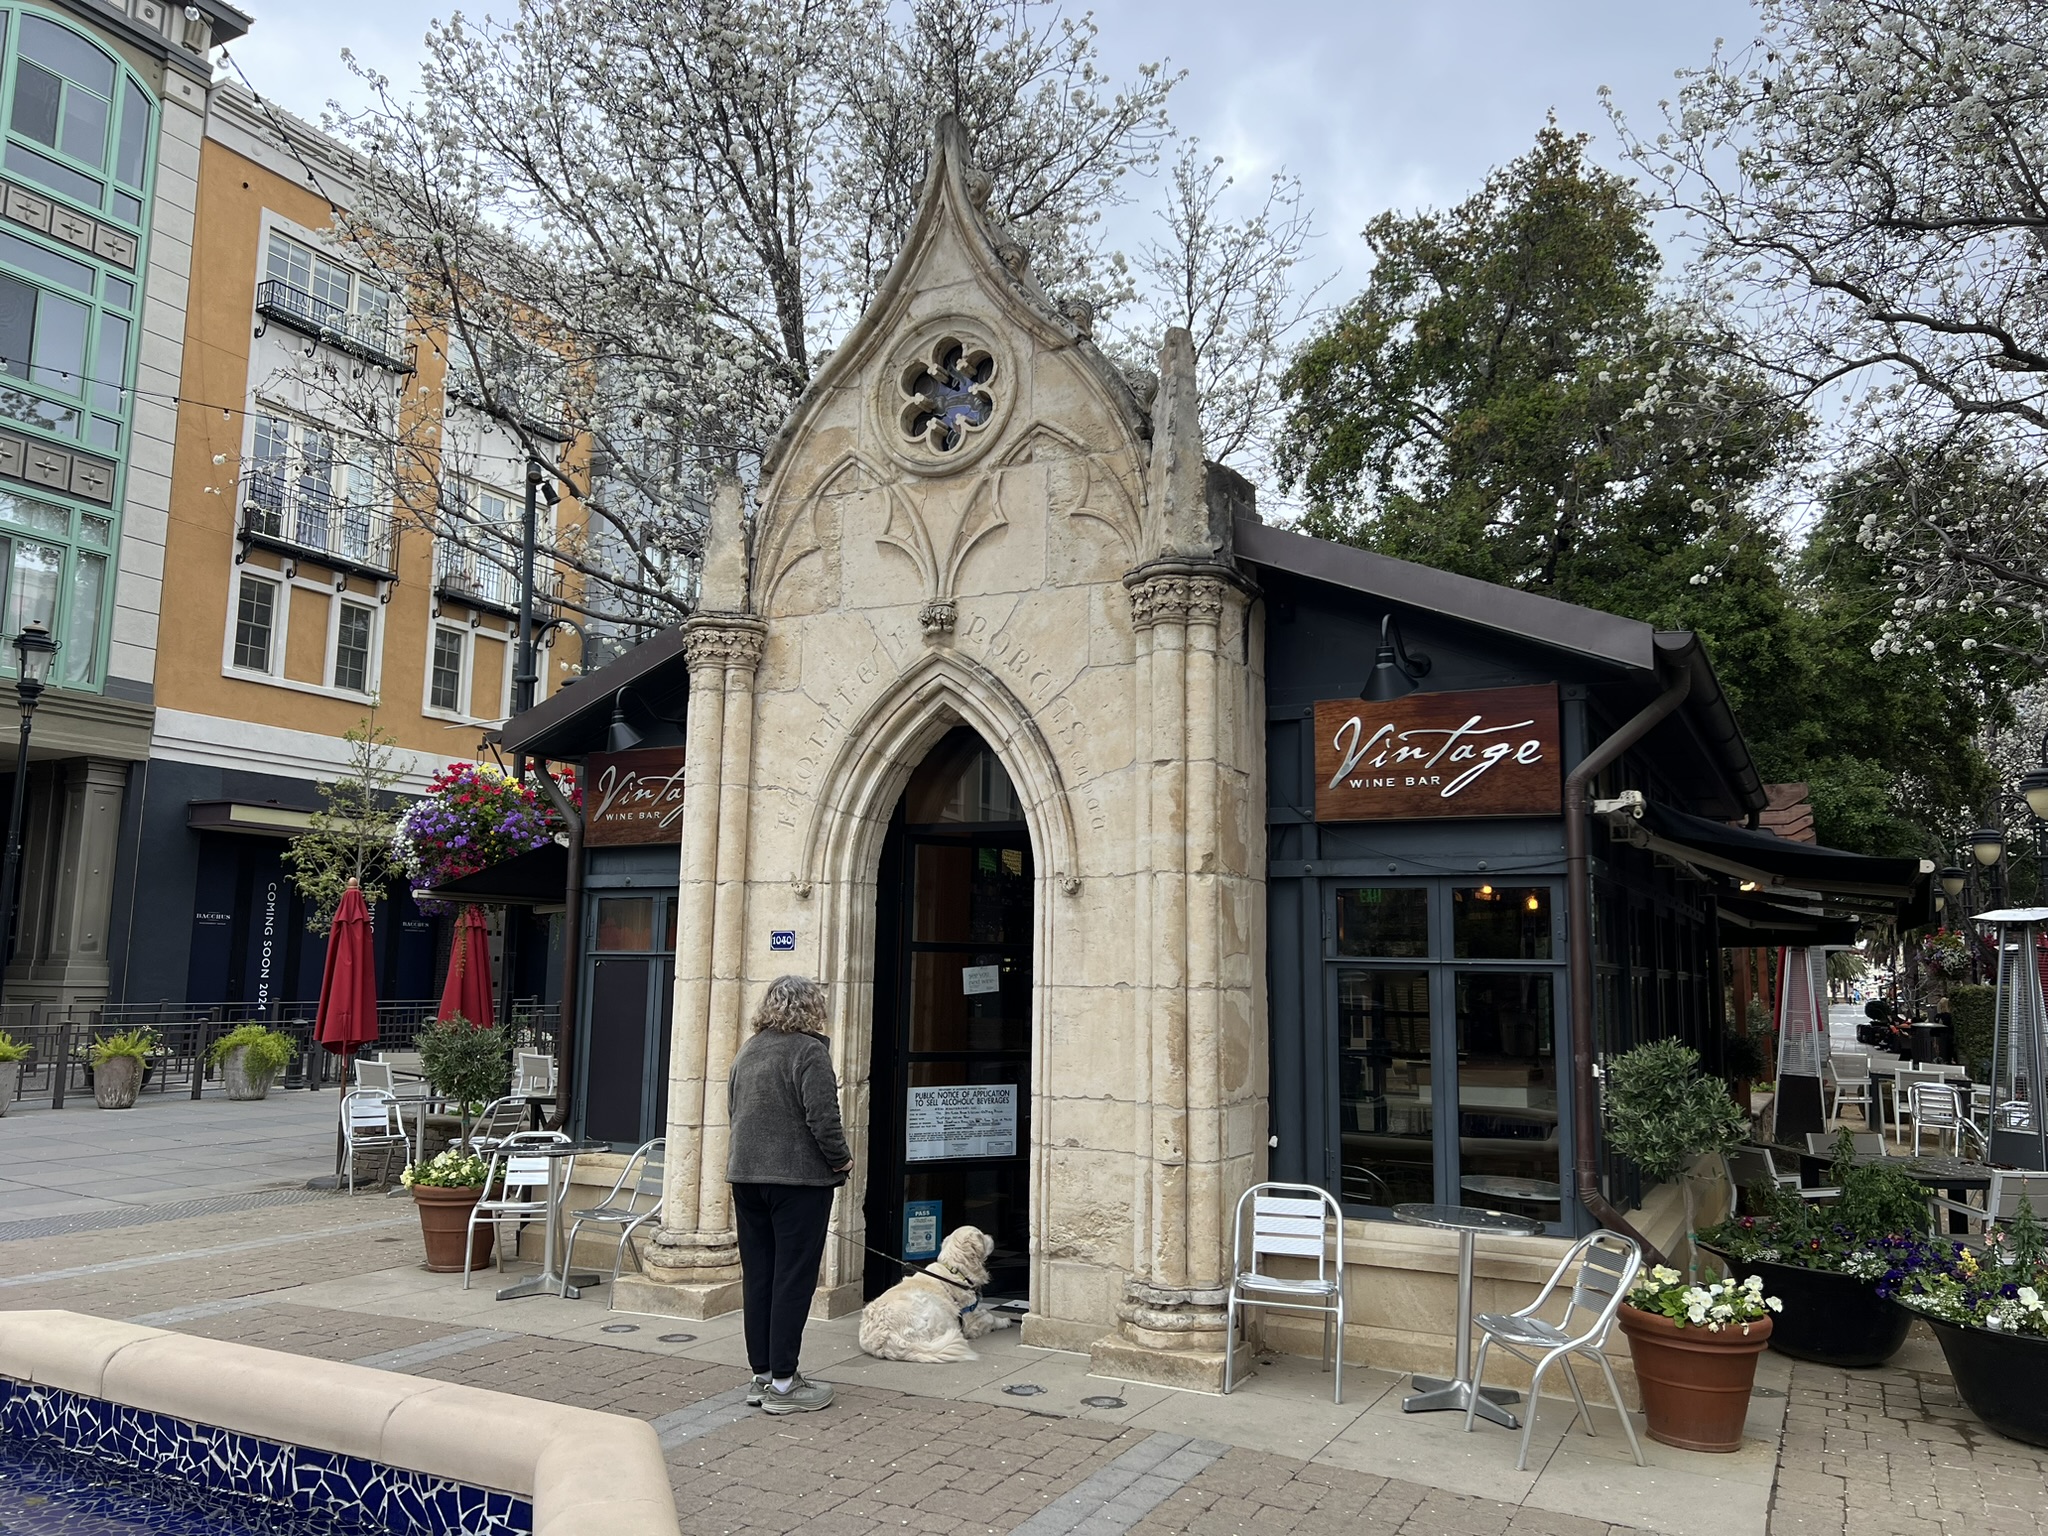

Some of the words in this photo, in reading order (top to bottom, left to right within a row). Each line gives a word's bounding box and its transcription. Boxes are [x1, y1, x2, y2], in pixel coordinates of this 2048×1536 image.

[1328, 714, 1544, 798] Vintage
[1349, 777, 1396, 789] WINE
[1405, 775, 1441, 786] BAR
[593, 765, 686, 828] Vinta
[605, 812, 633, 821] WINE
[638, 811, 661, 820] BAR
[263, 882, 277, 936] COMING
[772, 935, 792, 945] 1040
[260, 940, 272, 979] SOON
[257, 983, 269, 1011] 2024
[915, 1091, 935, 1100] PUBLIC
[937, 1090, 959, 1099] NOTICE
[962, 1090, 970, 1098] OF
[972, 1089, 1010, 1098] APPLICATION
[915, 1099, 924, 1107] TO
[942, 1098, 975, 1106] ALCOHOLIC
[977, 1096, 1010, 1105] BEVERAGES
